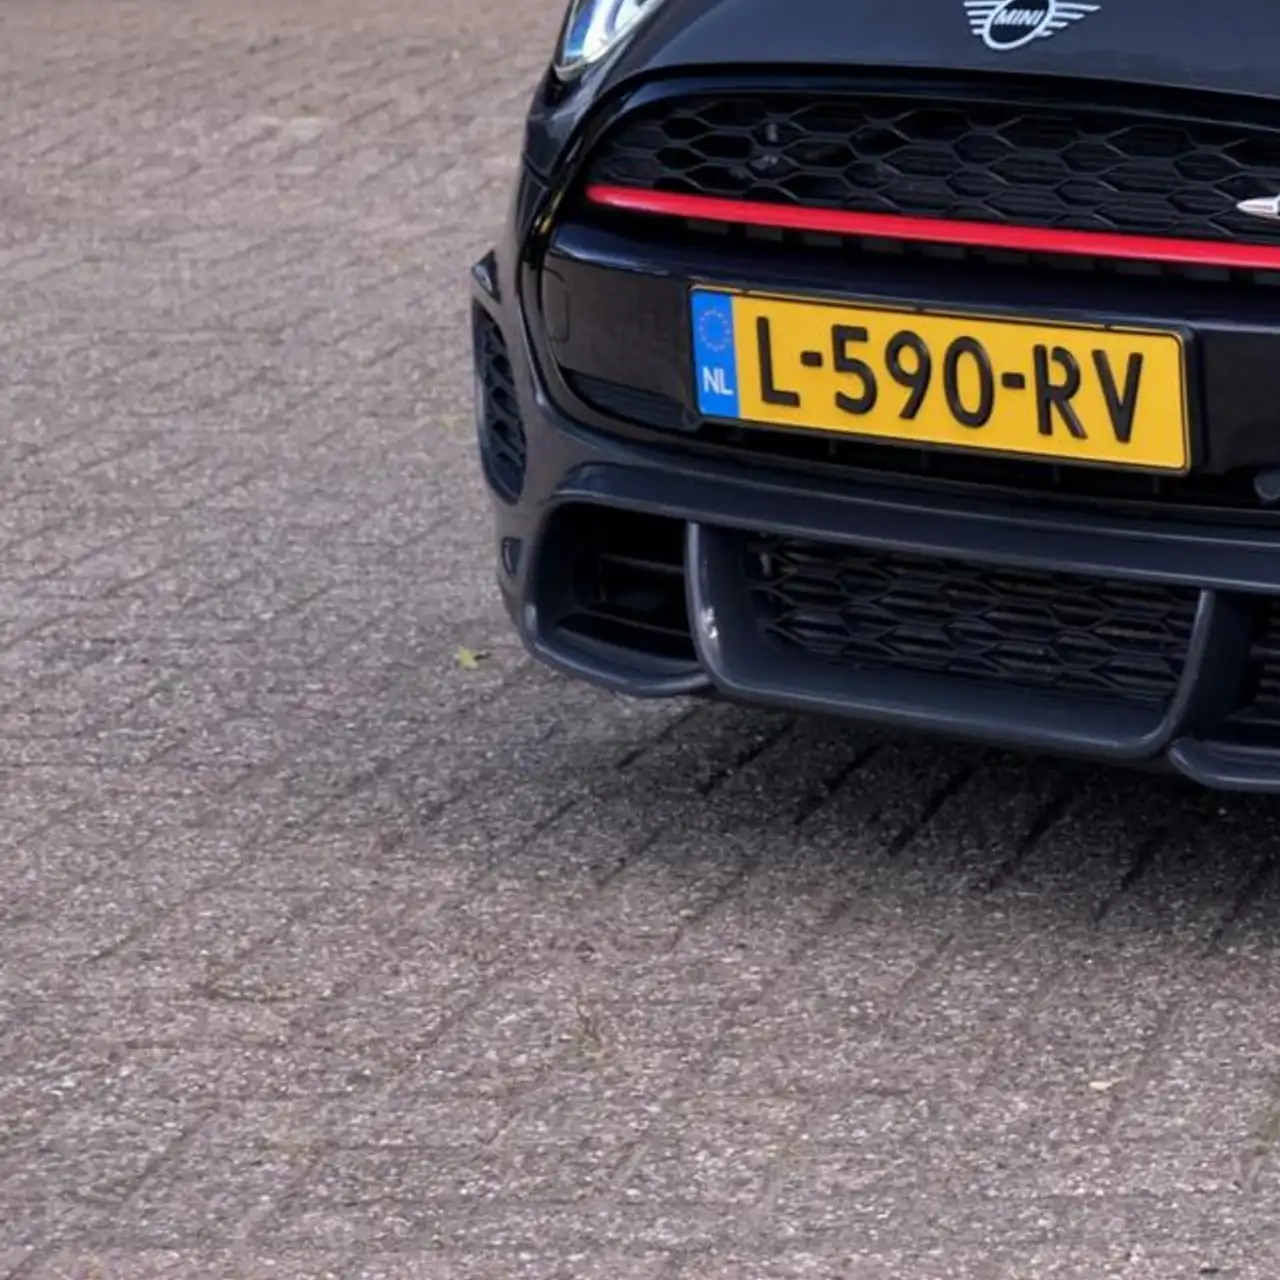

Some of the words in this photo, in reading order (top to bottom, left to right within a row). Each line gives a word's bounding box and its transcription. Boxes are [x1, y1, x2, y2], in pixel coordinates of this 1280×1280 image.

[994, 9, 1045, 26] MINI
[702, 367, 734, 397] NL
[755, 316, 1143, 444] L-590-RV
